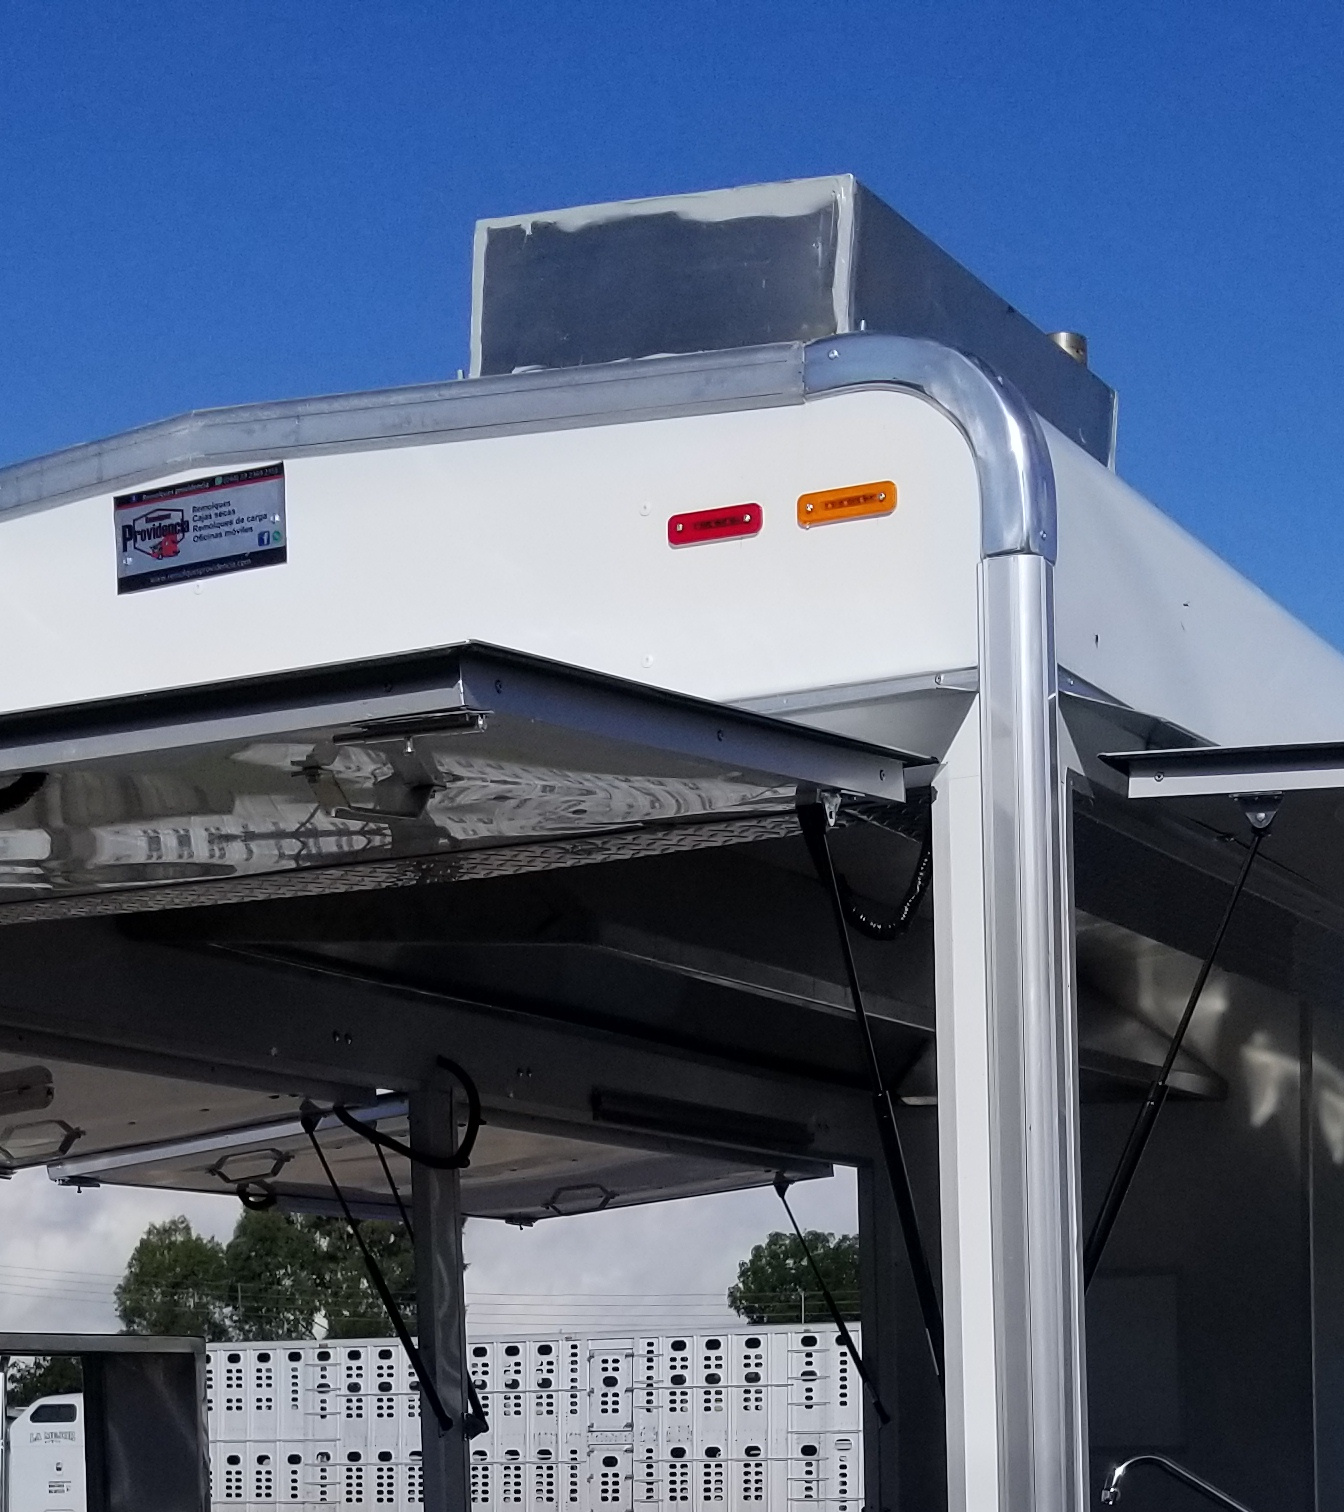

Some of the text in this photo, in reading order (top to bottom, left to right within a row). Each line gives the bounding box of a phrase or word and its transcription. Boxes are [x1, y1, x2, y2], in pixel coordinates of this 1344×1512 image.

[192, 501, 231, 513] Remolques
[192, 508, 236, 523] Cajas secas
[192, 513, 268, 533] Remolques de carga
[122, 519, 190, 553] Providencia
[192, 531, 223, 543] Oficinas
